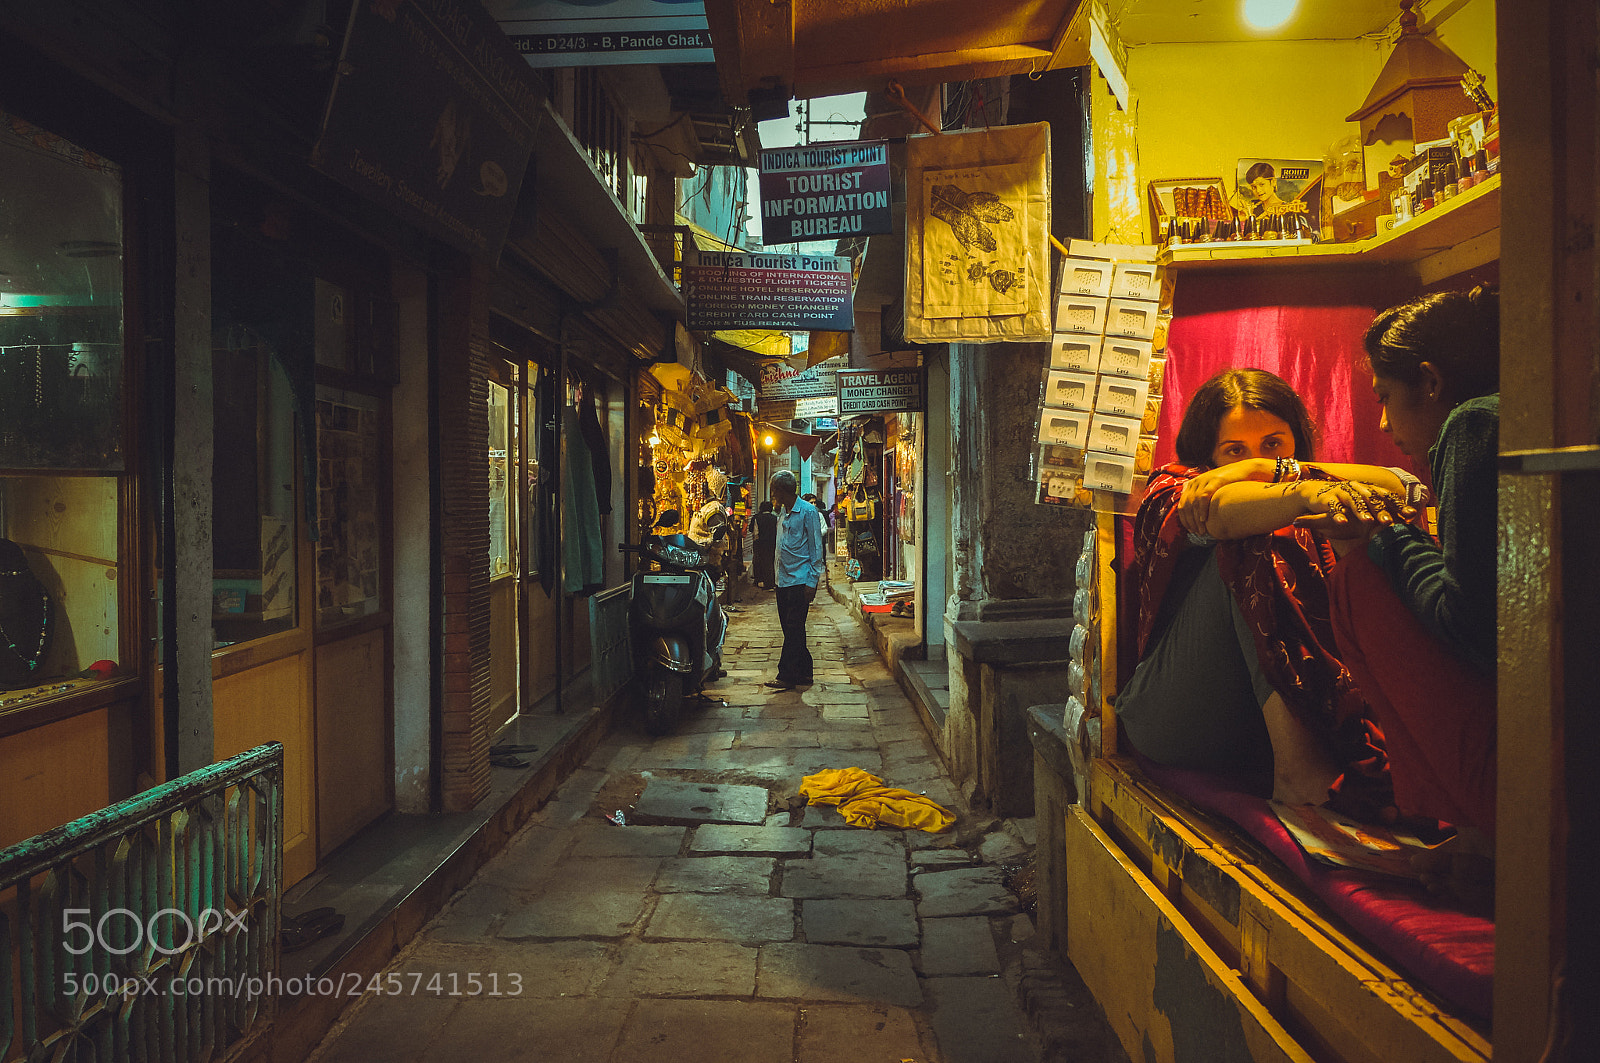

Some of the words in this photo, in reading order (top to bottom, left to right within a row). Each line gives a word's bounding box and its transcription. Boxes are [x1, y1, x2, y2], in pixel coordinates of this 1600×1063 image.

[602, 36, 616, 48] B,
[620, 33, 663, 47] Pande
[667, 32, 704, 48] Ghat,
[764, 152, 800, 170] INDICA
[802, 148, 848, 168] TOURIST
[852, 146, 883, 164] POINT
[786, 172, 863, 194] TOURIST
[765, 191, 888, 217] INFORMATION
[791, 215, 862, 237] BUREAU
[698, 253, 743, 267] Indica
[748, 254, 797, 269] Tourist
[802, 258, 839, 271] Point
[765, 278, 802, 286] FLIGHT
[804, 279, 847, 287] TICKETS
[766, 271, 848, 281] INTERNATIONAL
[776, 287, 847, 295] RESERVATION
[774, 295, 845, 303] RESERVATION
[841, 374, 881, 387] TRAVEL
[883, 373, 918, 385] AGENT
[847, 388, 874, 397] MONEY
[876, 387, 913, 396] CHANGER
[843, 402, 861, 410] CREDIT
[862, 401, 876, 409] CARD
[877, 400, 891, 408] CASH
[892, 399, 906, 407] POINT
